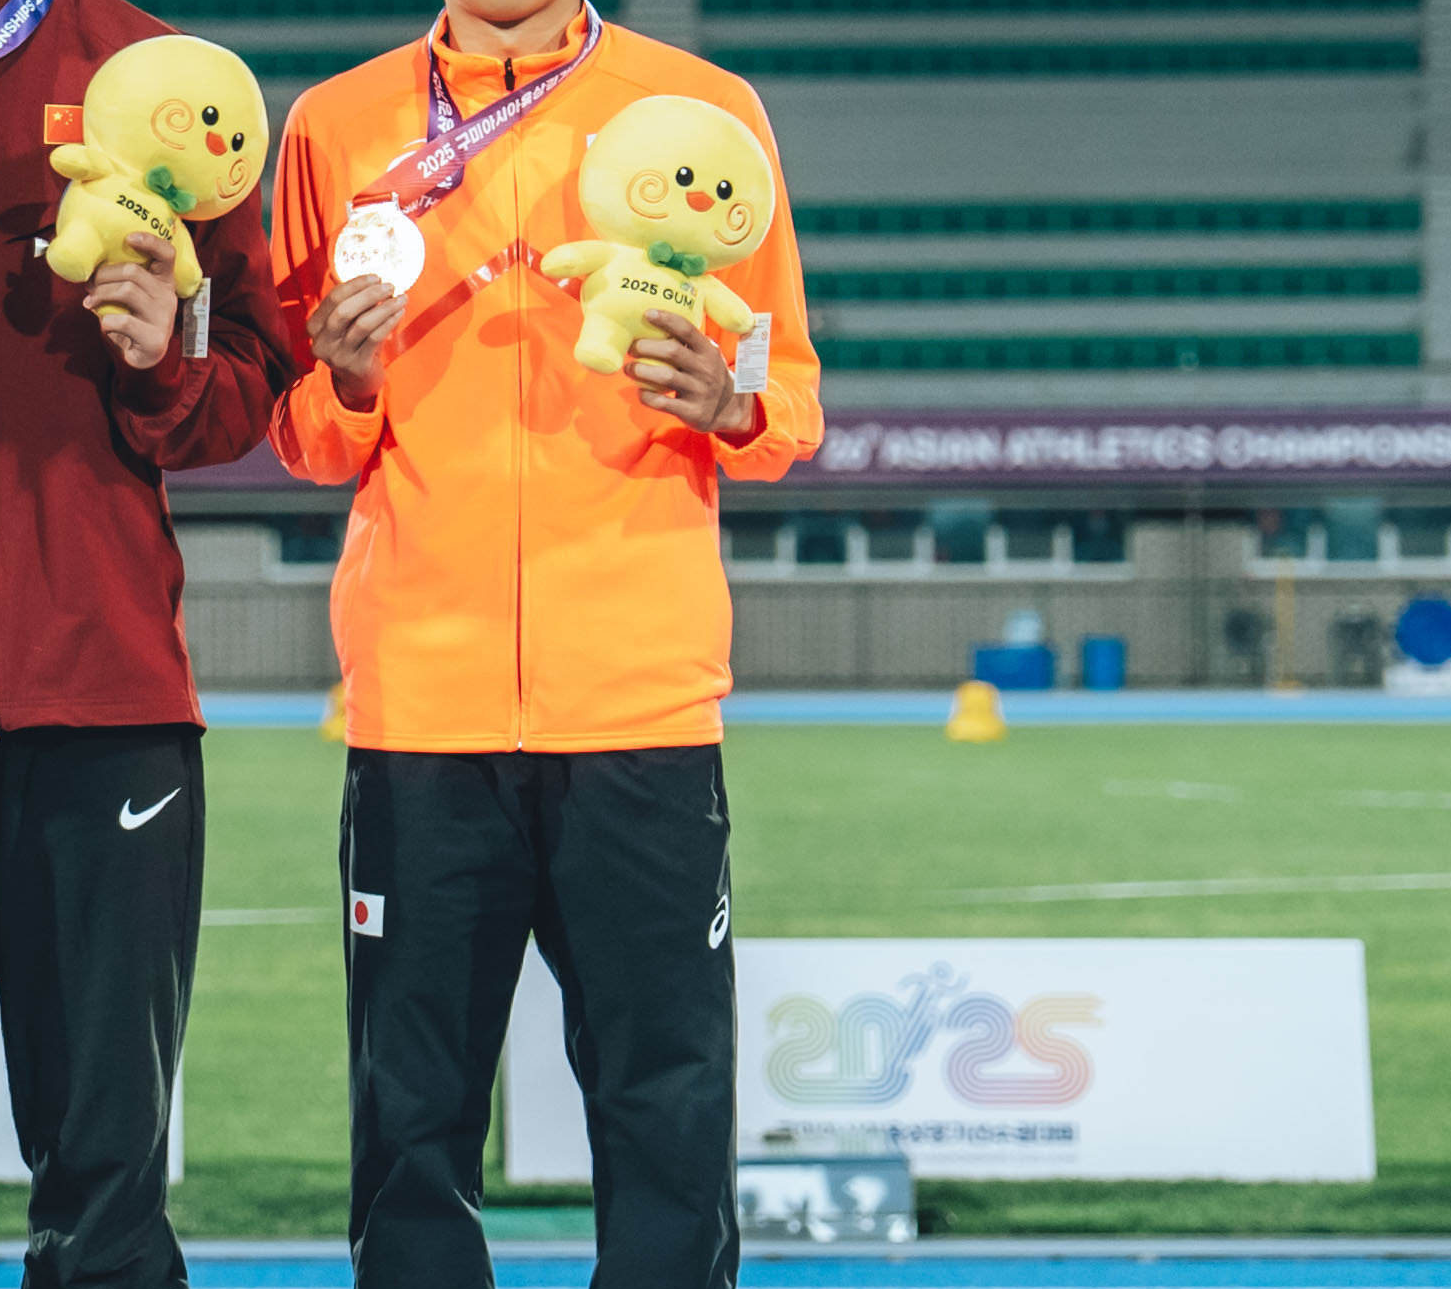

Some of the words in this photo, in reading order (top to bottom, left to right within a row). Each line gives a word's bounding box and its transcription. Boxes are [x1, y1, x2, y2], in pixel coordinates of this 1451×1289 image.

[416, 142, 457, 179] 2025
[116, 194, 149, 221] 2025
[621, 277, 658, 295] 2025
[662, 288, 695, 310] GUMI
[1002, 425, 1215, 470] ATHLETICS
